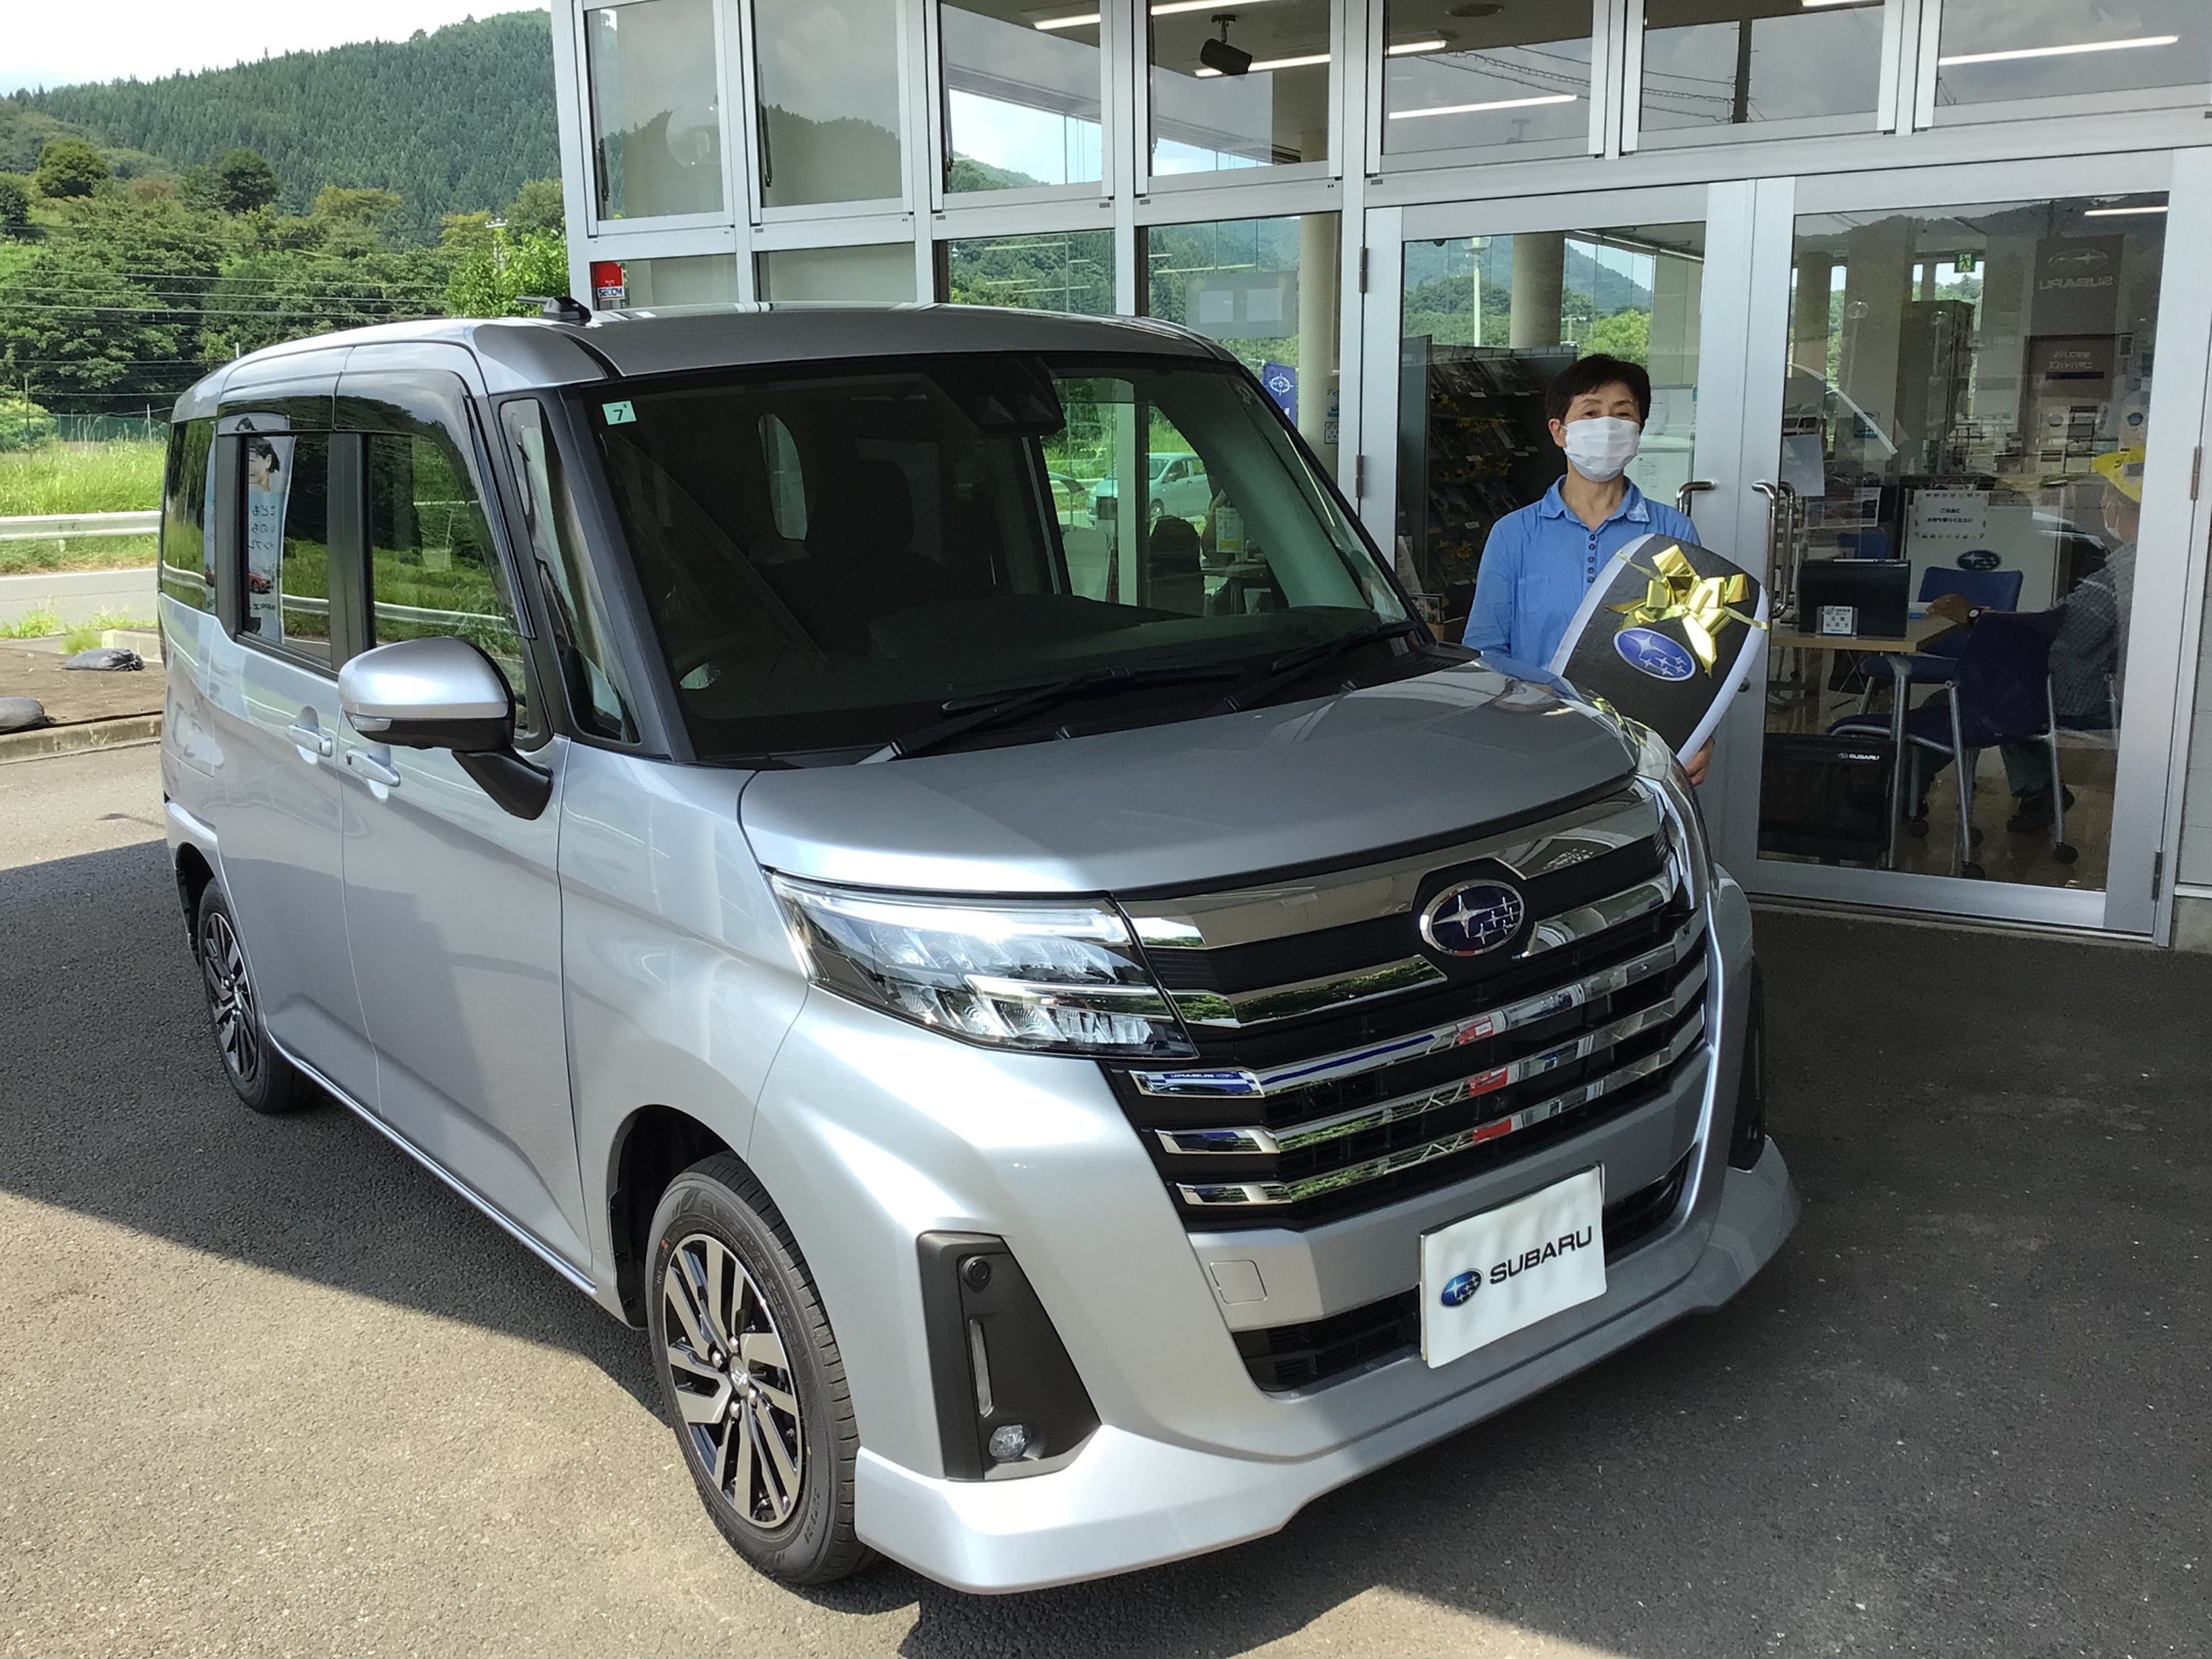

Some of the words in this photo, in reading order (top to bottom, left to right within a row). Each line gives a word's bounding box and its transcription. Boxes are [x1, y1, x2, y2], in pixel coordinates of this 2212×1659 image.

[599, 287, 623, 297] SECOM
[613, 409, 623, 422] 7
[1490, 1225, 1593, 1285] SUBARU
